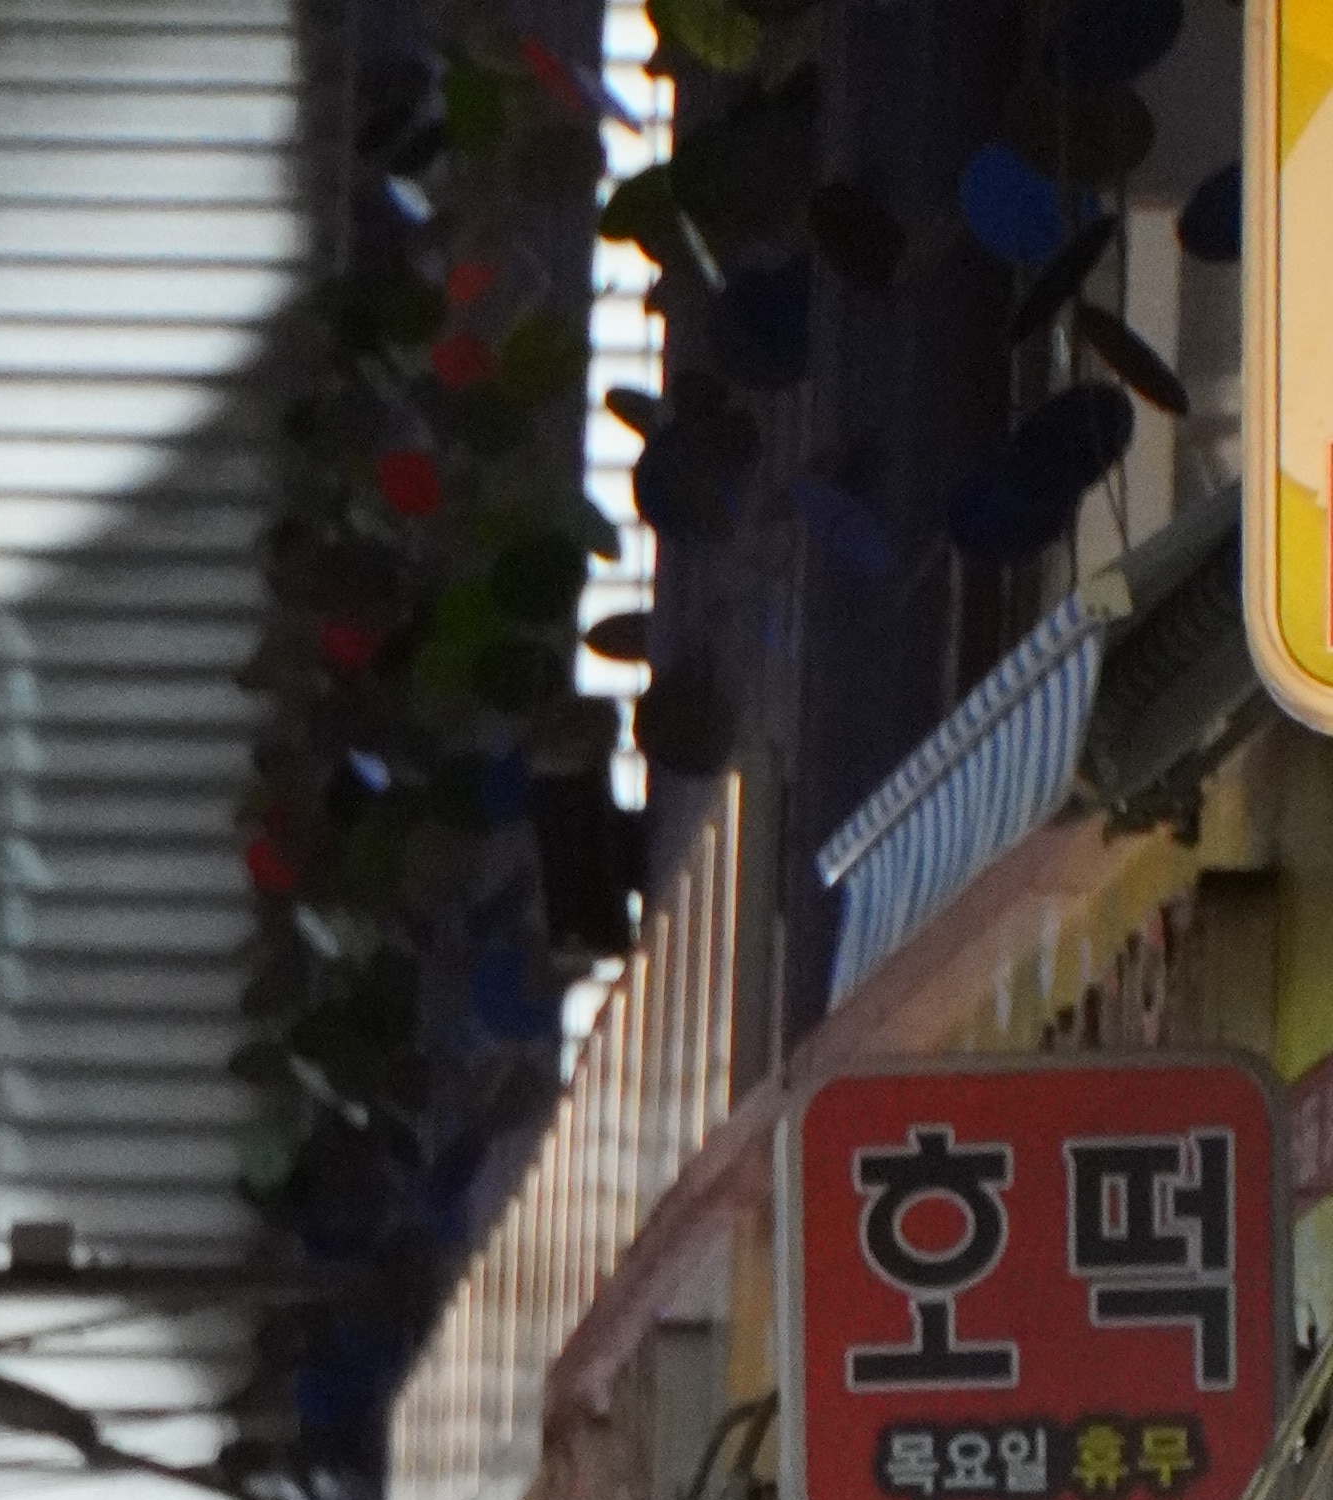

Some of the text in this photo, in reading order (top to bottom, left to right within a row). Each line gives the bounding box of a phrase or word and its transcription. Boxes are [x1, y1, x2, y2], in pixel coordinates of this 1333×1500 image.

[846, 1125, 1236, 1391] 호떡
[886, 1422, 1196, 1497] 목요일 휴무
